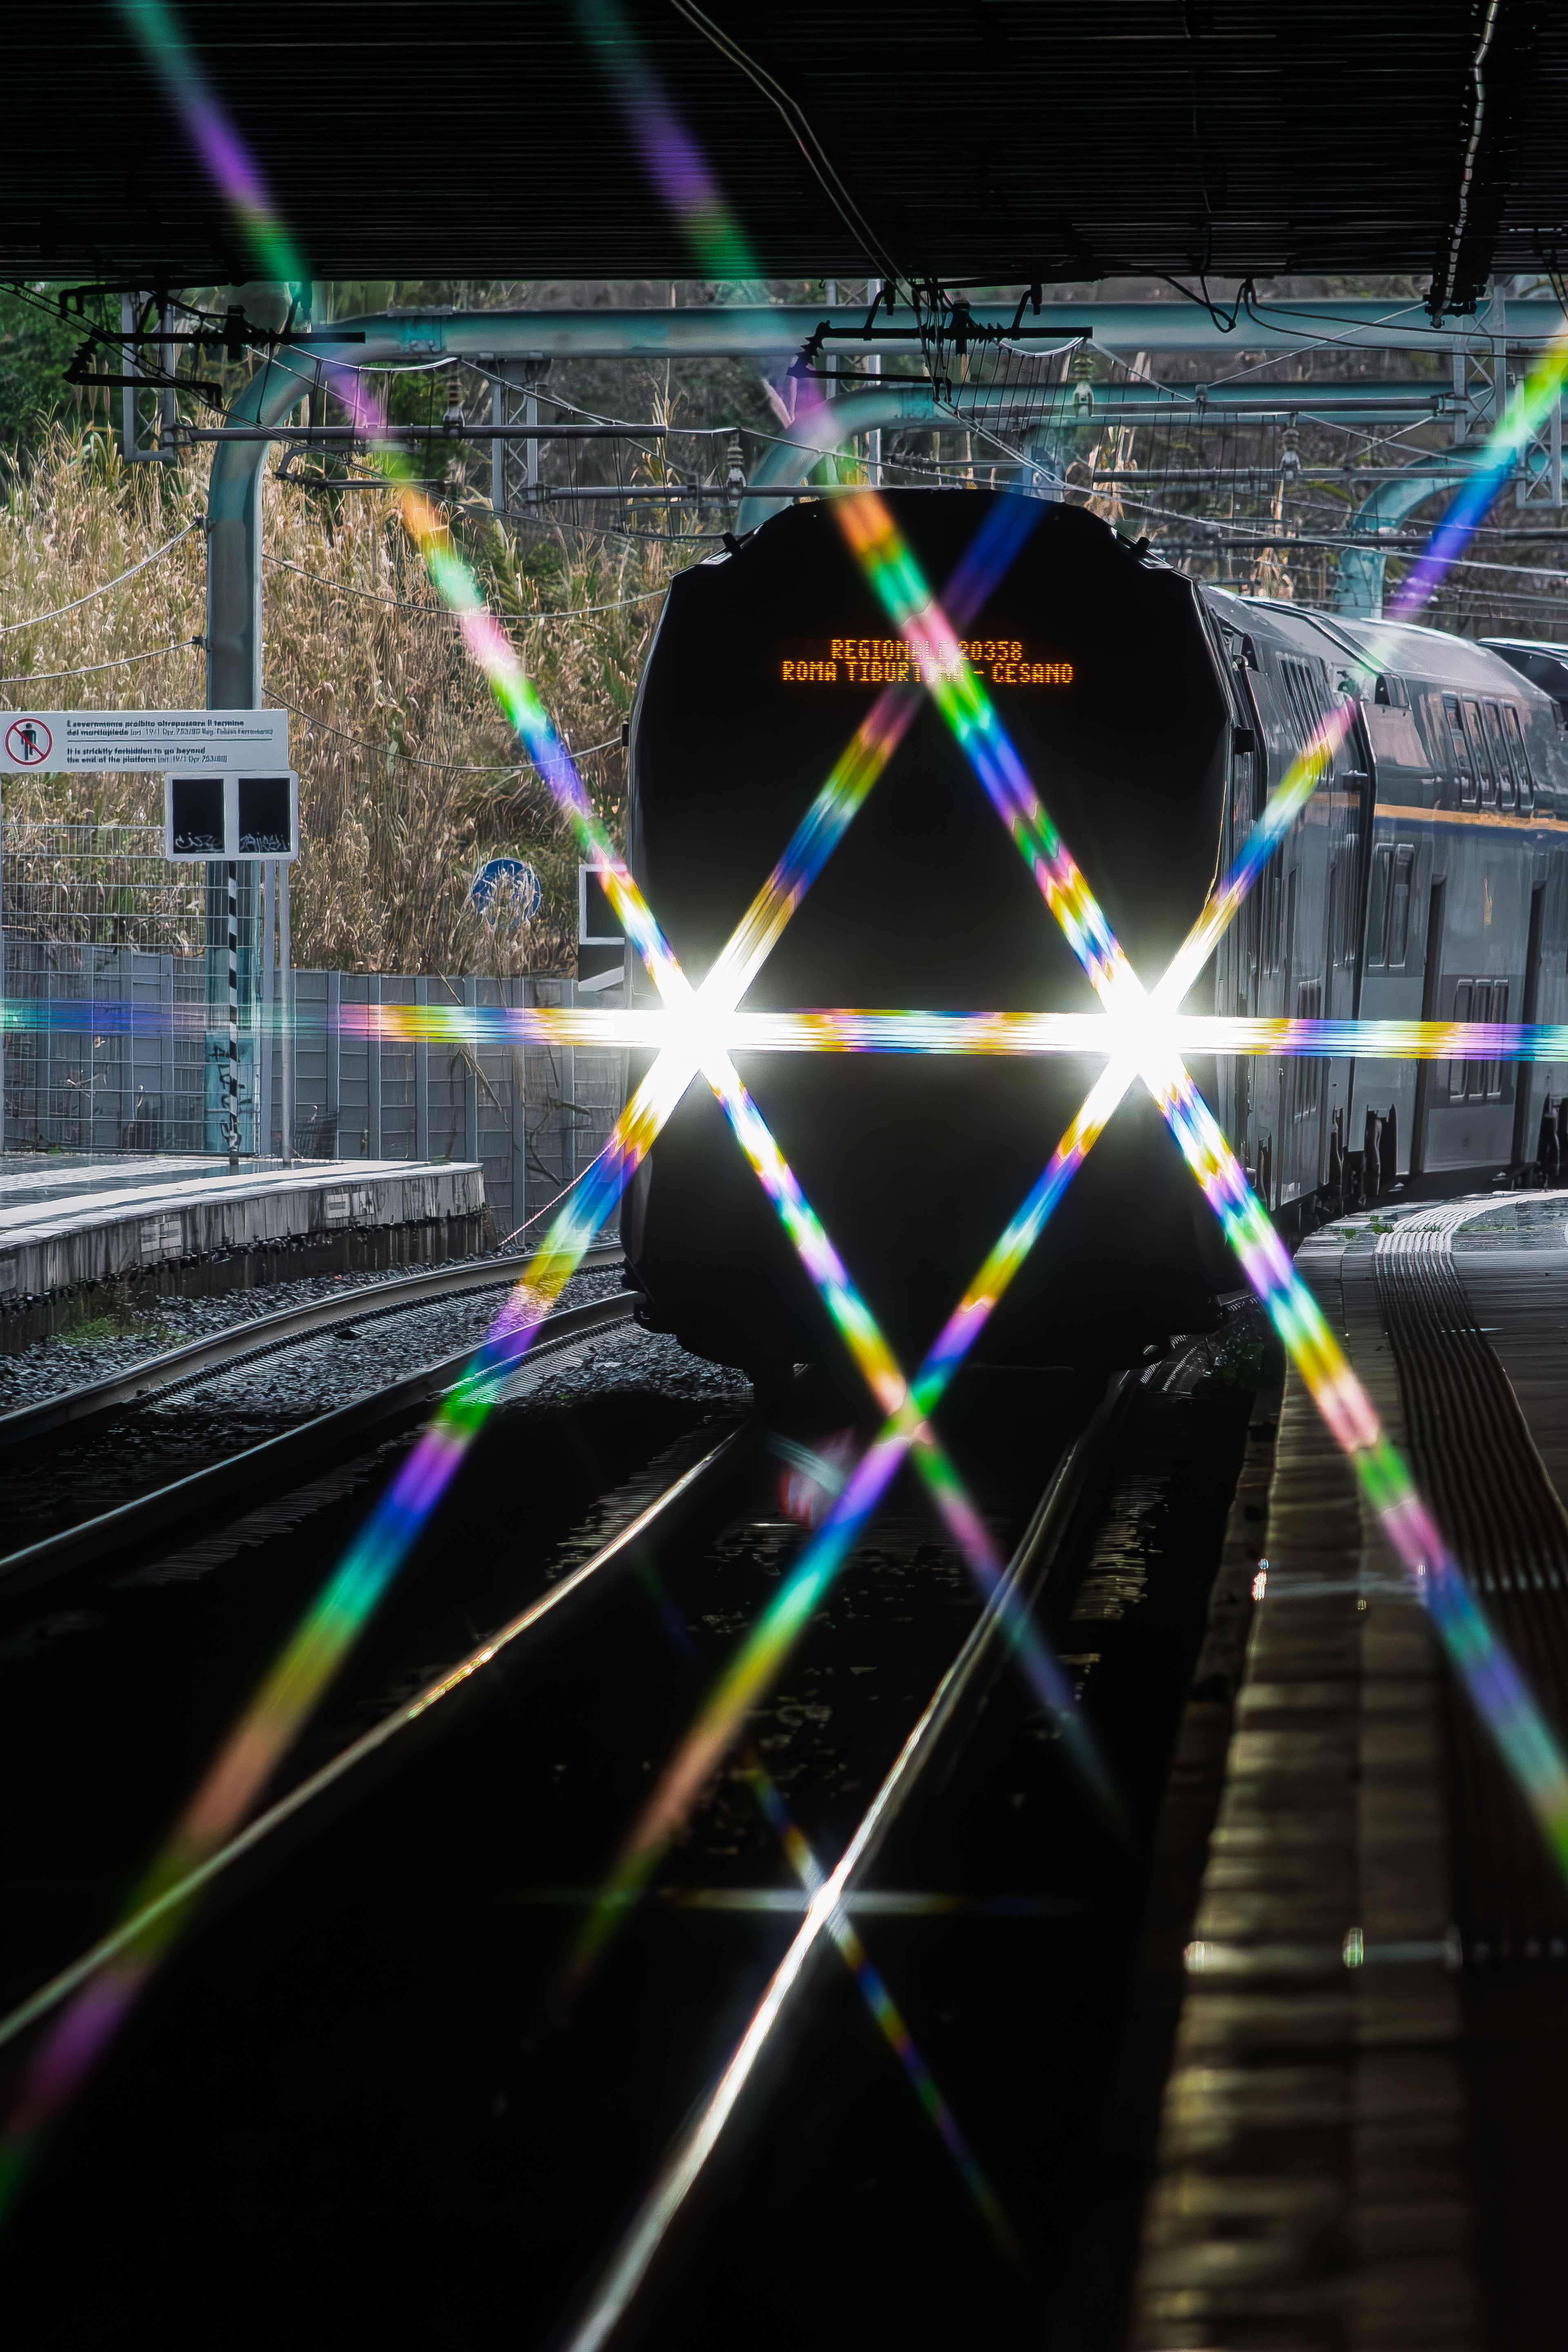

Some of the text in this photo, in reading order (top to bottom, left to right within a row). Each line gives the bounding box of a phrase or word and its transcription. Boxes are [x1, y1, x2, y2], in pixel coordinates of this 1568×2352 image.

[831, 639, 949, 659] REGIONALE
[782, 662, 837, 682] ROMA
[844, 661, 964, 683] TIBURTINA
[991, 662, 1073, 684] CESANO
